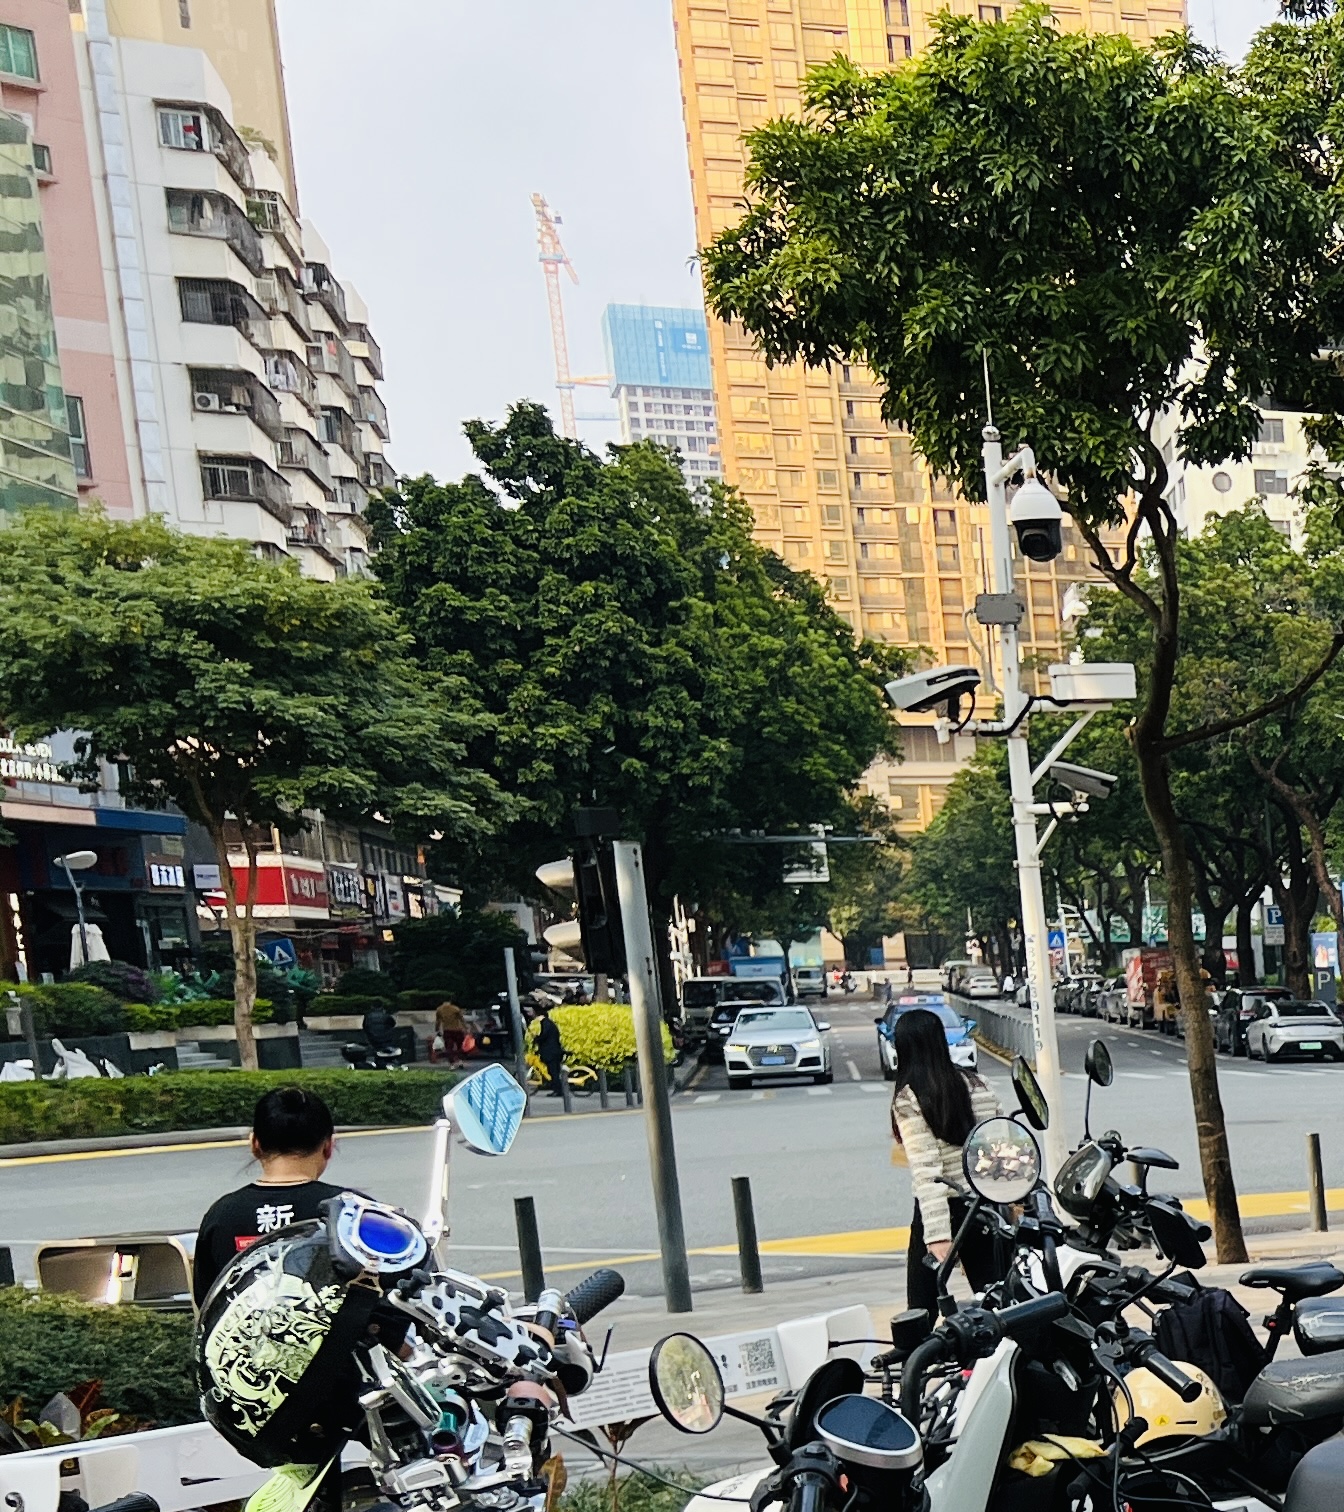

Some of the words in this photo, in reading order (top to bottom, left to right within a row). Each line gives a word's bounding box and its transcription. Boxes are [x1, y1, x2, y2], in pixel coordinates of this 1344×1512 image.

[1270, 909, 1282, 924] P
[1317, 971, 1331, 990] P
[256, 1204, 295, 1233] 新
